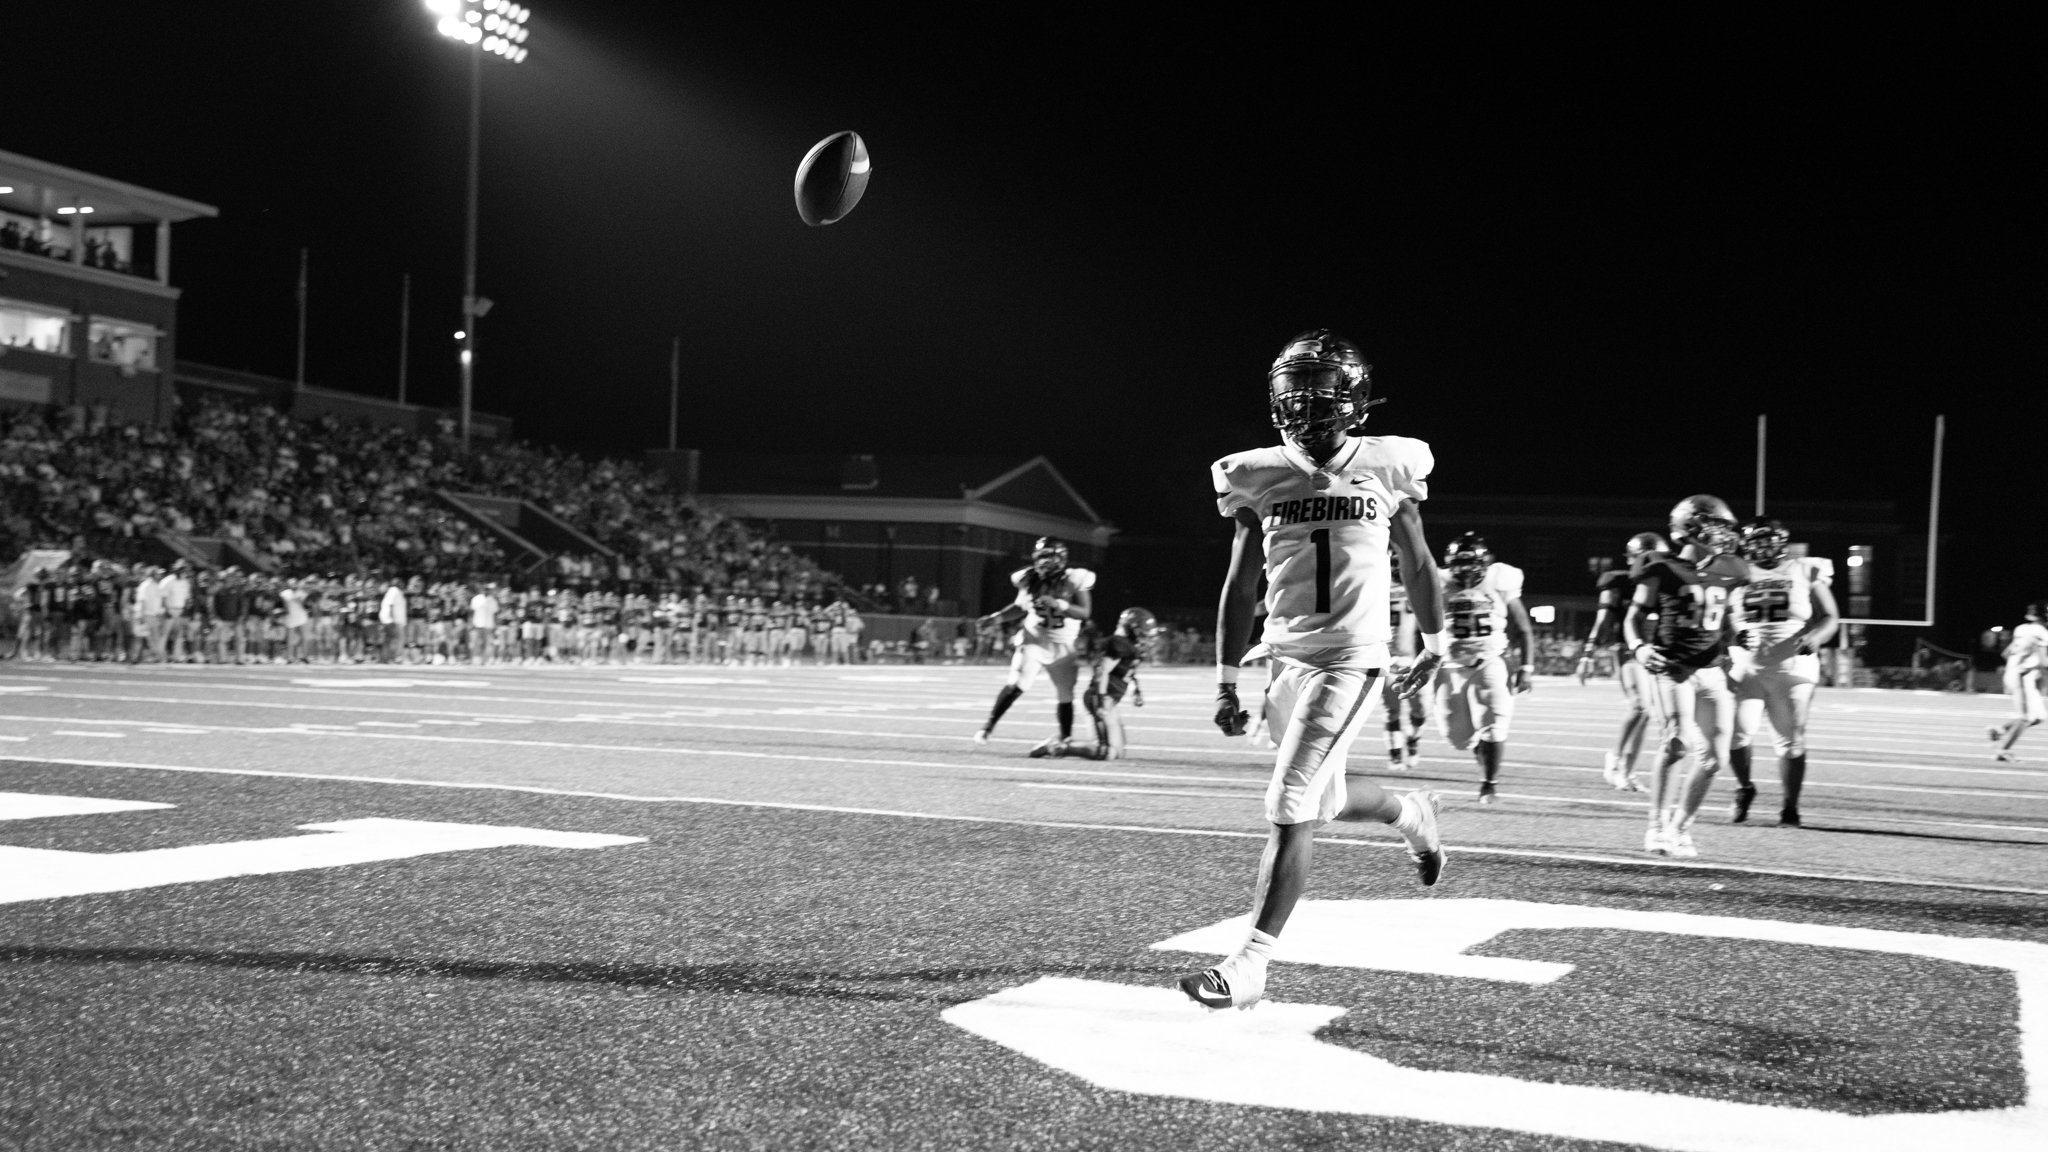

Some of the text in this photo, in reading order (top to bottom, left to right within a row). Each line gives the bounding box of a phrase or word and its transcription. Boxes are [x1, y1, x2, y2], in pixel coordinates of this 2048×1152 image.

[1270, 496, 1377, 527] FIREBIRDS
[1310, 528, 1331, 614] 1
[1677, 584, 1727, 631] 36
[1743, 591, 1790, 623] 52
[1453, 612, 1492, 639] 56
